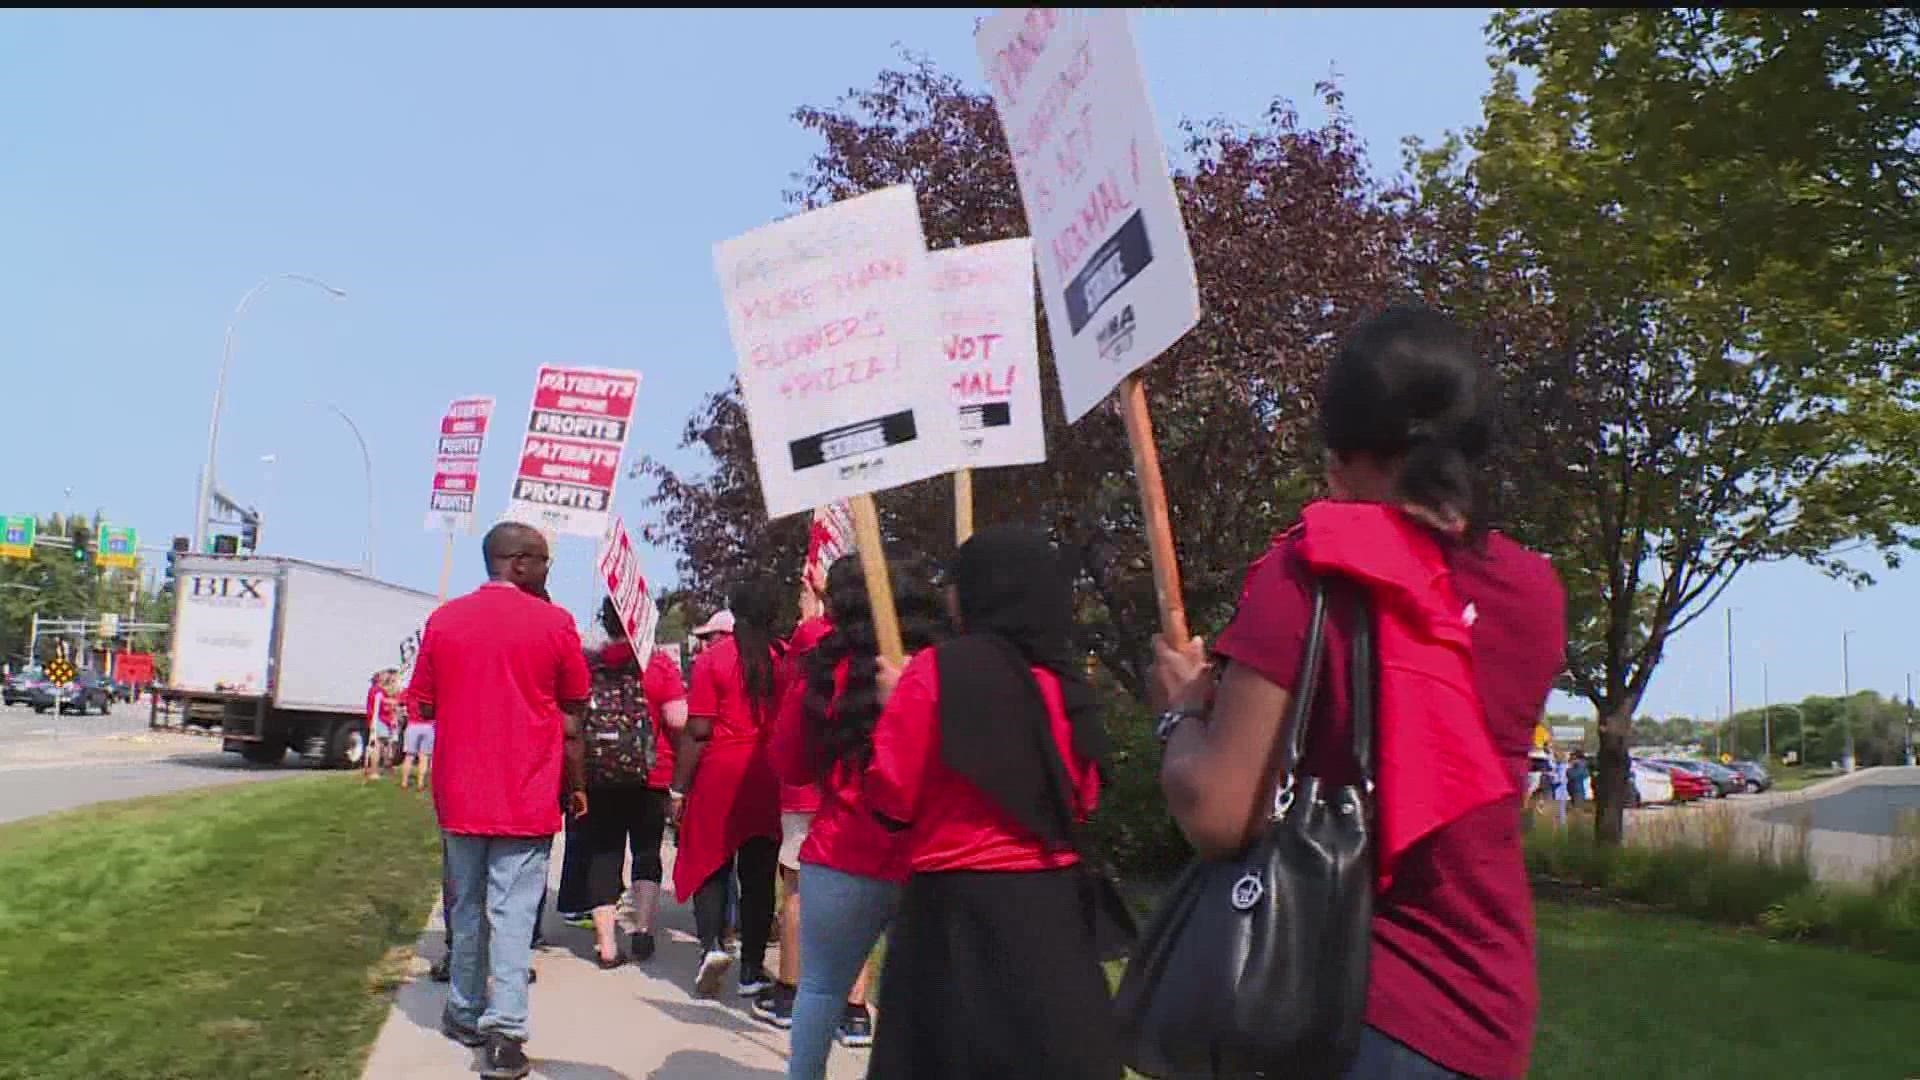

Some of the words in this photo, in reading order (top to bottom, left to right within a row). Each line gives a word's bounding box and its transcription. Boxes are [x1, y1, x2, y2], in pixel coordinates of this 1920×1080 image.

[541, 371, 635, 399] PATIENTS
[535, 411, 622, 440] PROFITS
[524, 440, 618, 469] PATIENTS
[518, 481, 604, 510] PROFITS
